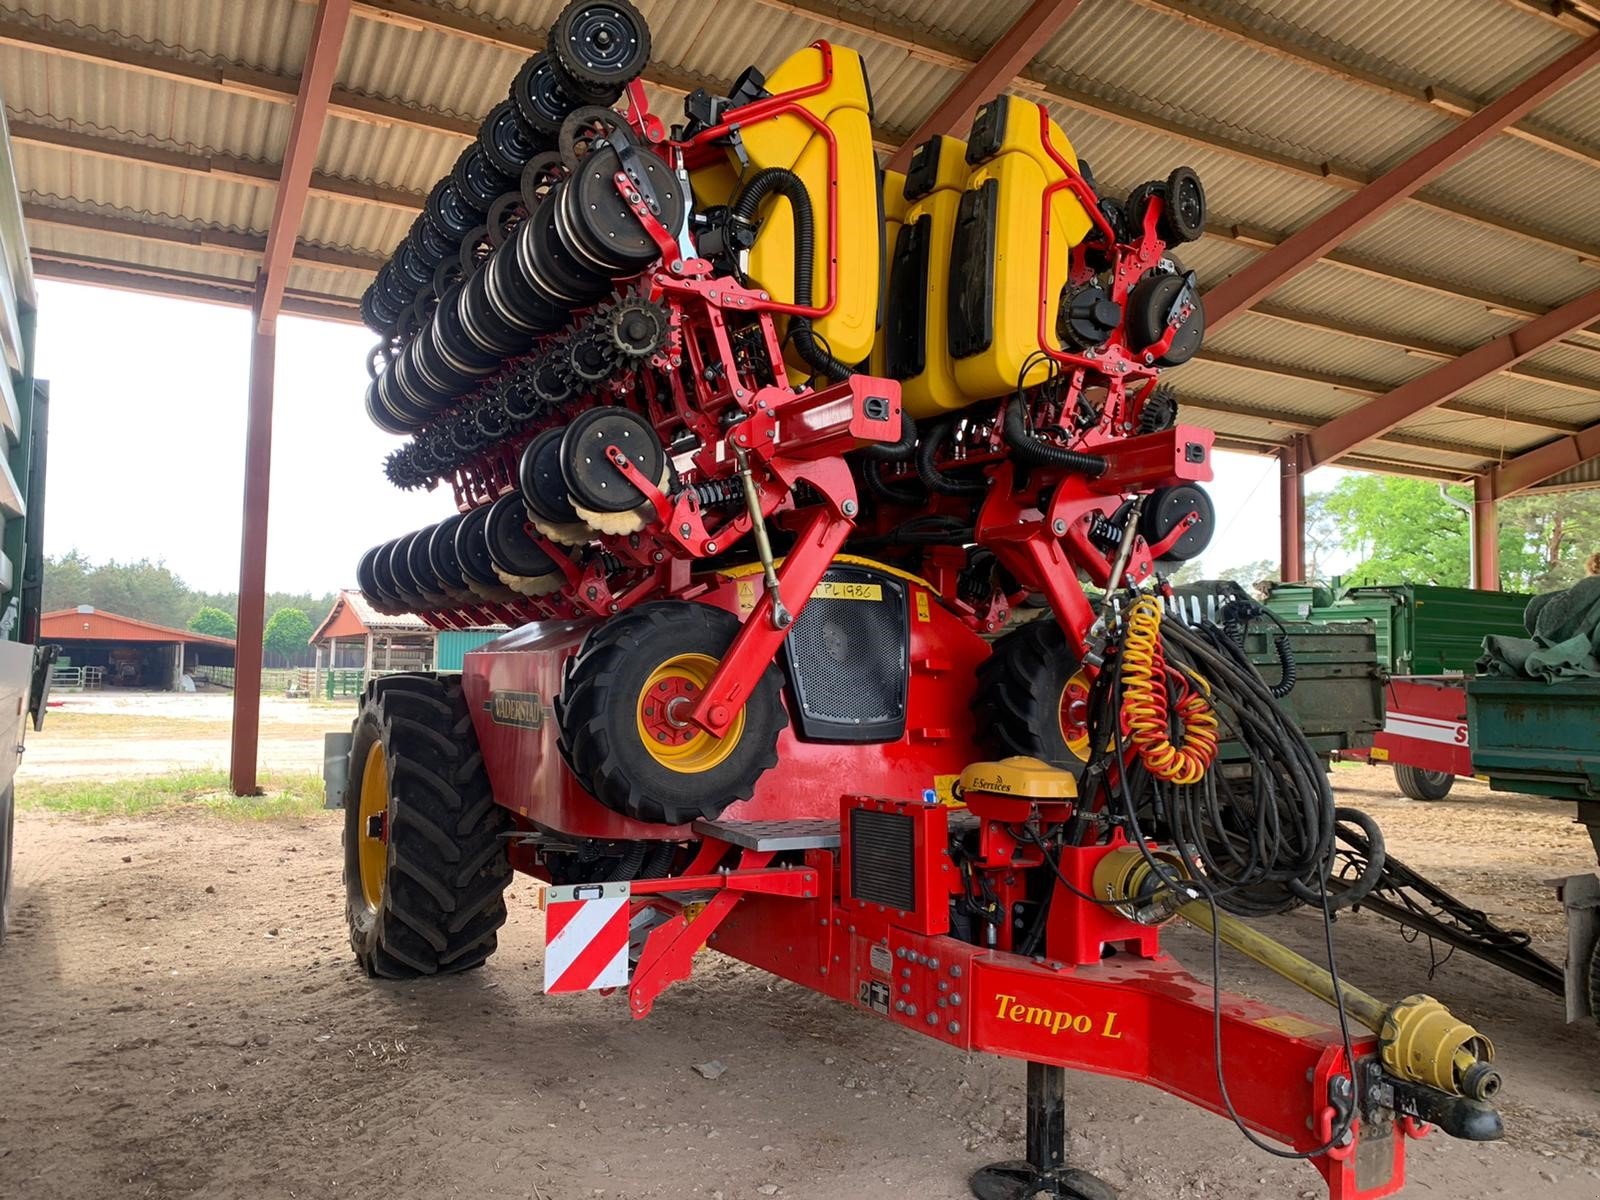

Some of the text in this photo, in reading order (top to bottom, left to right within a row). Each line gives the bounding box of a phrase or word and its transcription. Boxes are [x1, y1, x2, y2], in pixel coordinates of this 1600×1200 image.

[972, 777, 1012, 793] E-Services
[995, 994, 1122, 1039] Tempo L
